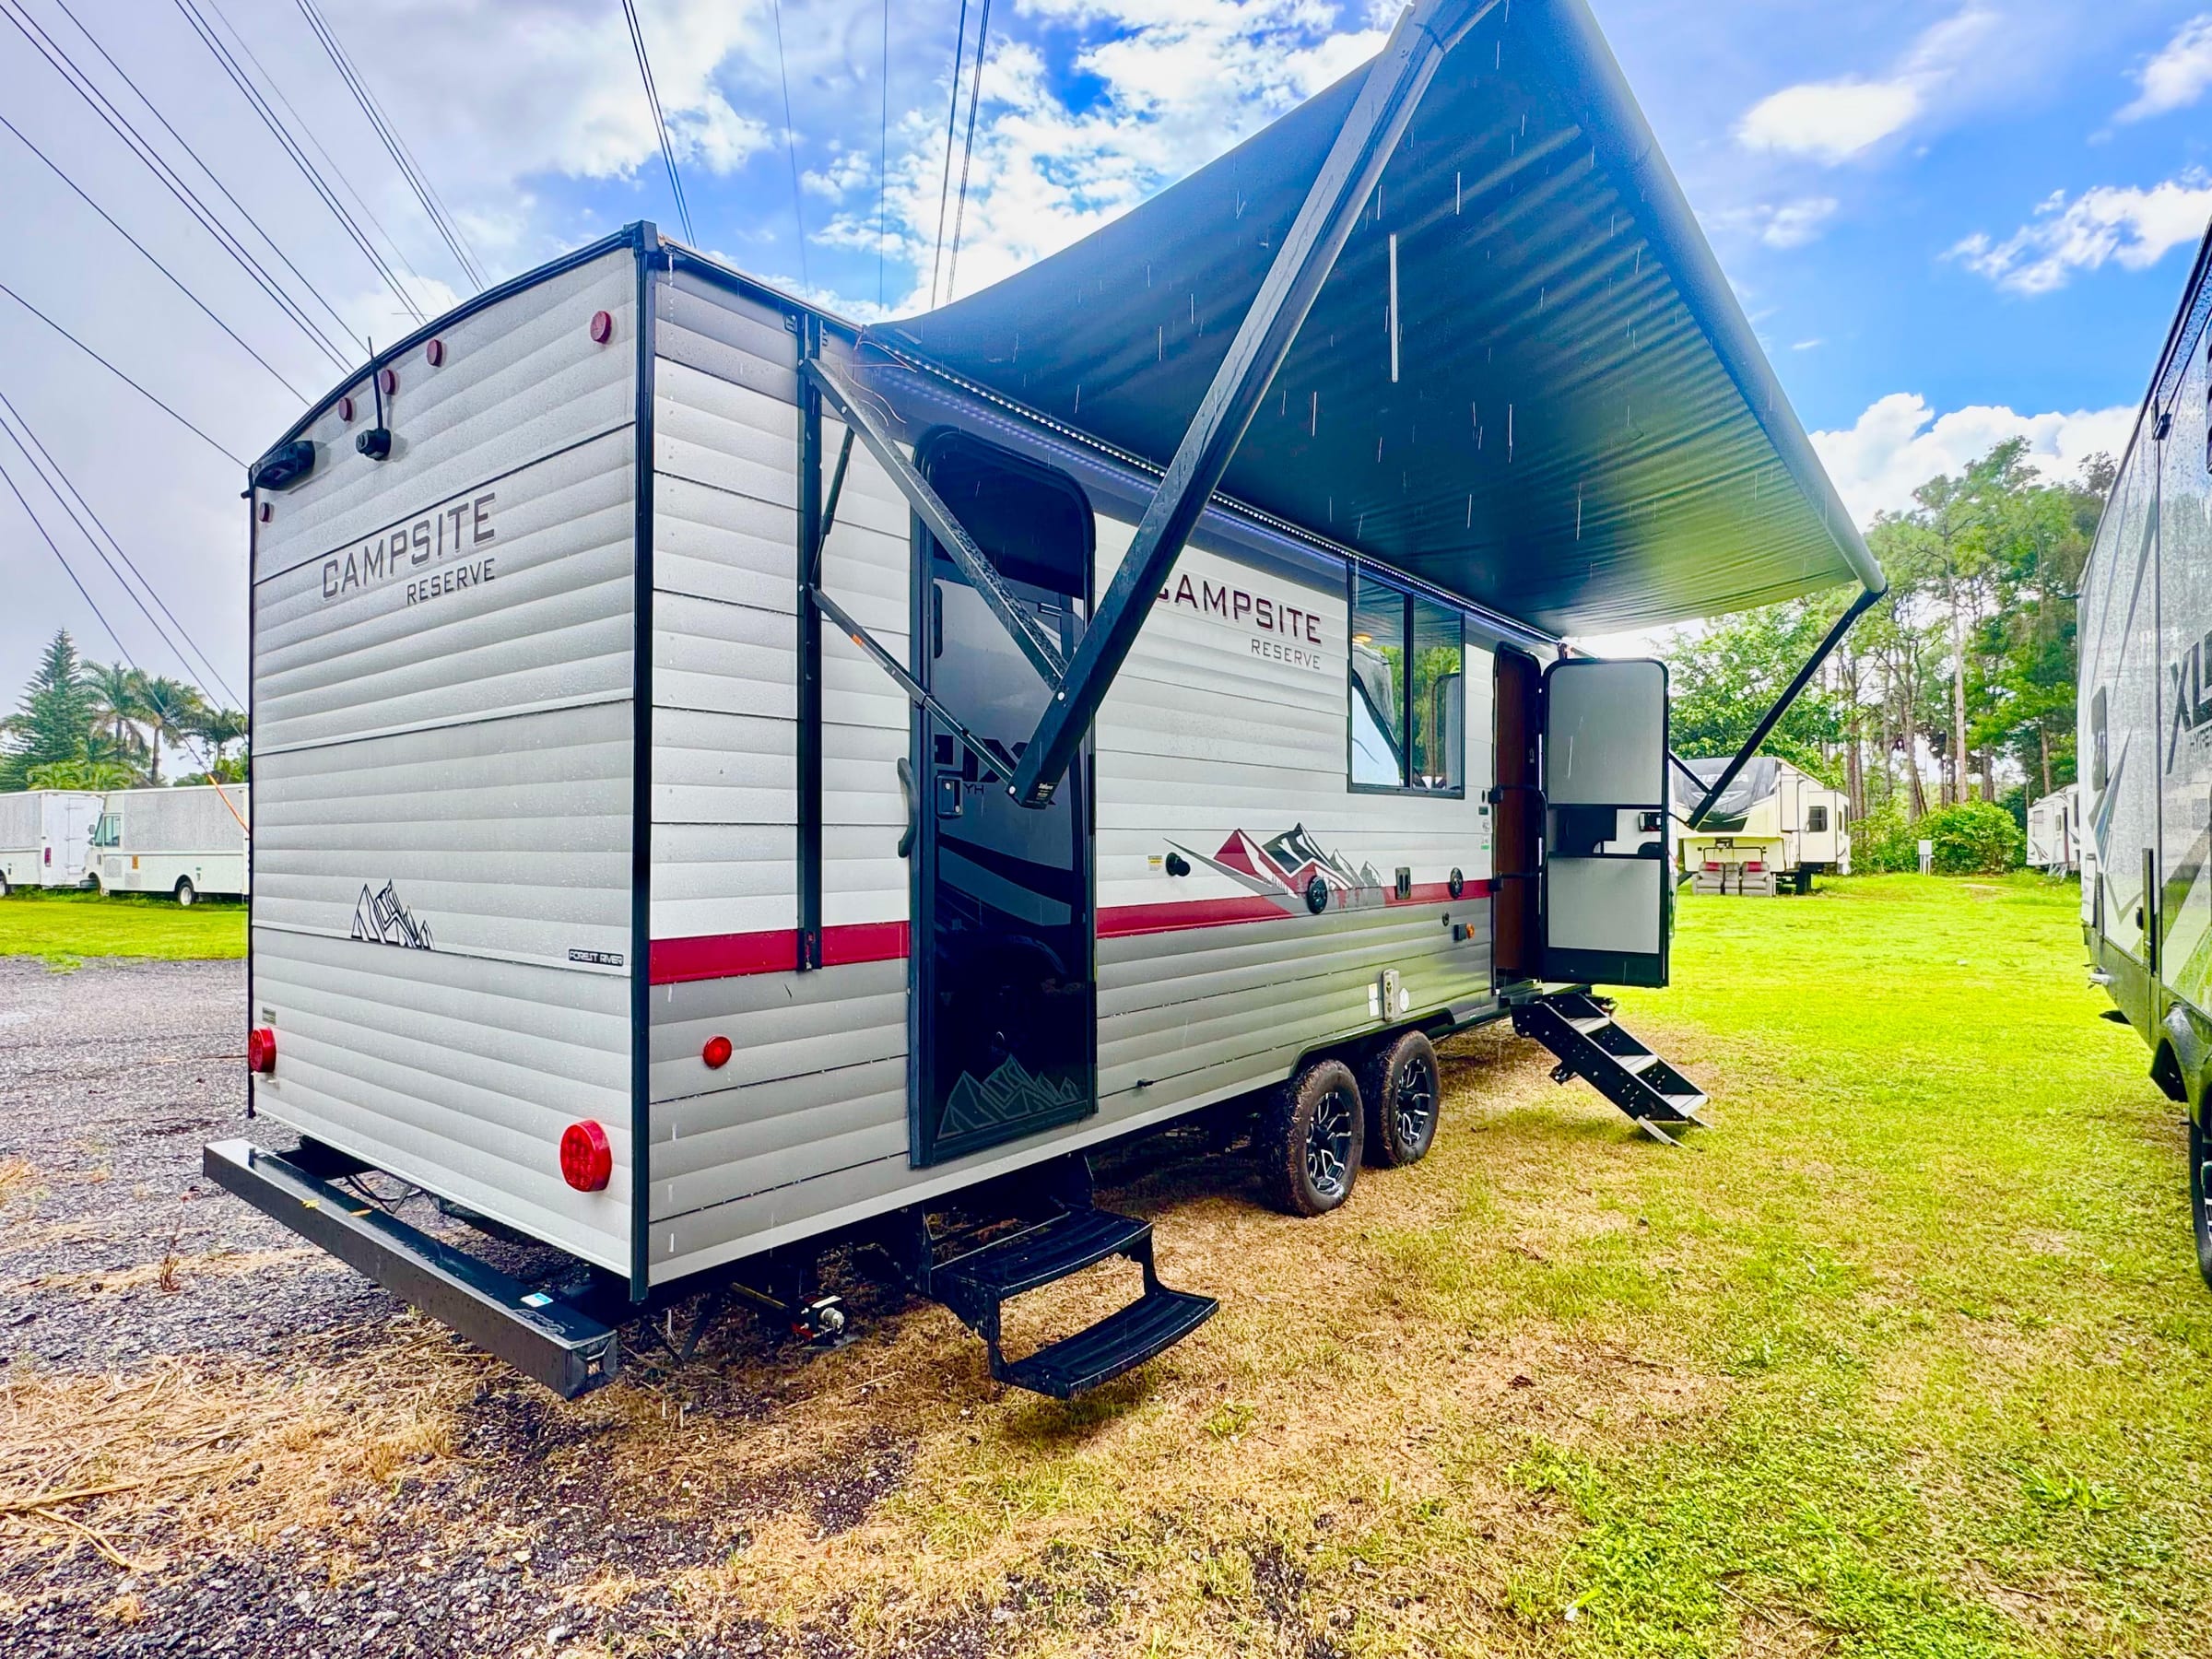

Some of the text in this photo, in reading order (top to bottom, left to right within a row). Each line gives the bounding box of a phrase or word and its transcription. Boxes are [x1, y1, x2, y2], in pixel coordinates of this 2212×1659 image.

[324, 492, 496, 599] CAMPSITE
[406, 558, 495, 606] RESERVE
[1158, 574, 1322, 644] AMPSITE
[1252, 638, 1321, 670] RESERVE
[569, 950, 624, 965] FOREST RIVER
